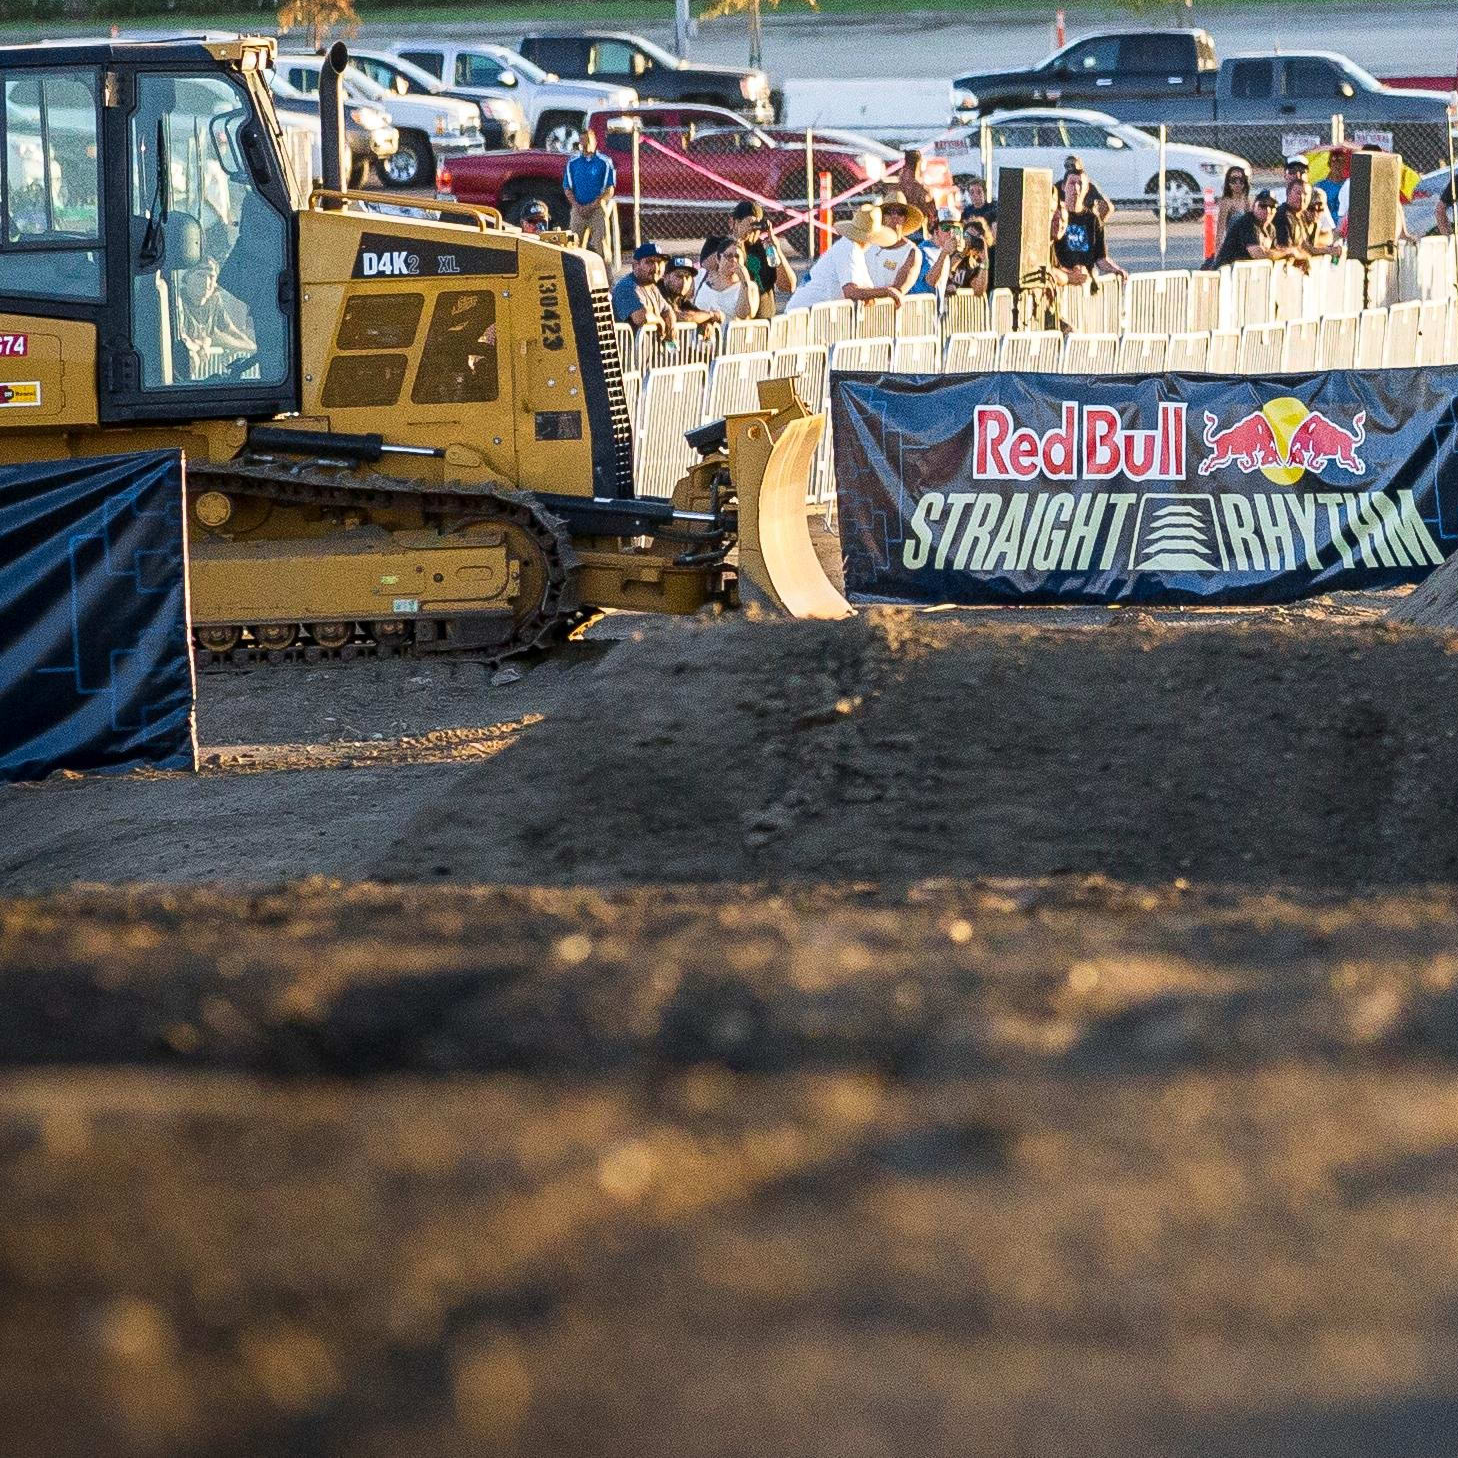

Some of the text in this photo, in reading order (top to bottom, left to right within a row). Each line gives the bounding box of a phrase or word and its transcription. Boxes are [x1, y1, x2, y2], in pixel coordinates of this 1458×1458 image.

[437, 254, 460, 274] XL
[0, 335, 24, 355] 74
[973, 401, 1187, 482] Red Bull
[903, 489, 1446, 571] STRAIGHT RHYTHM
